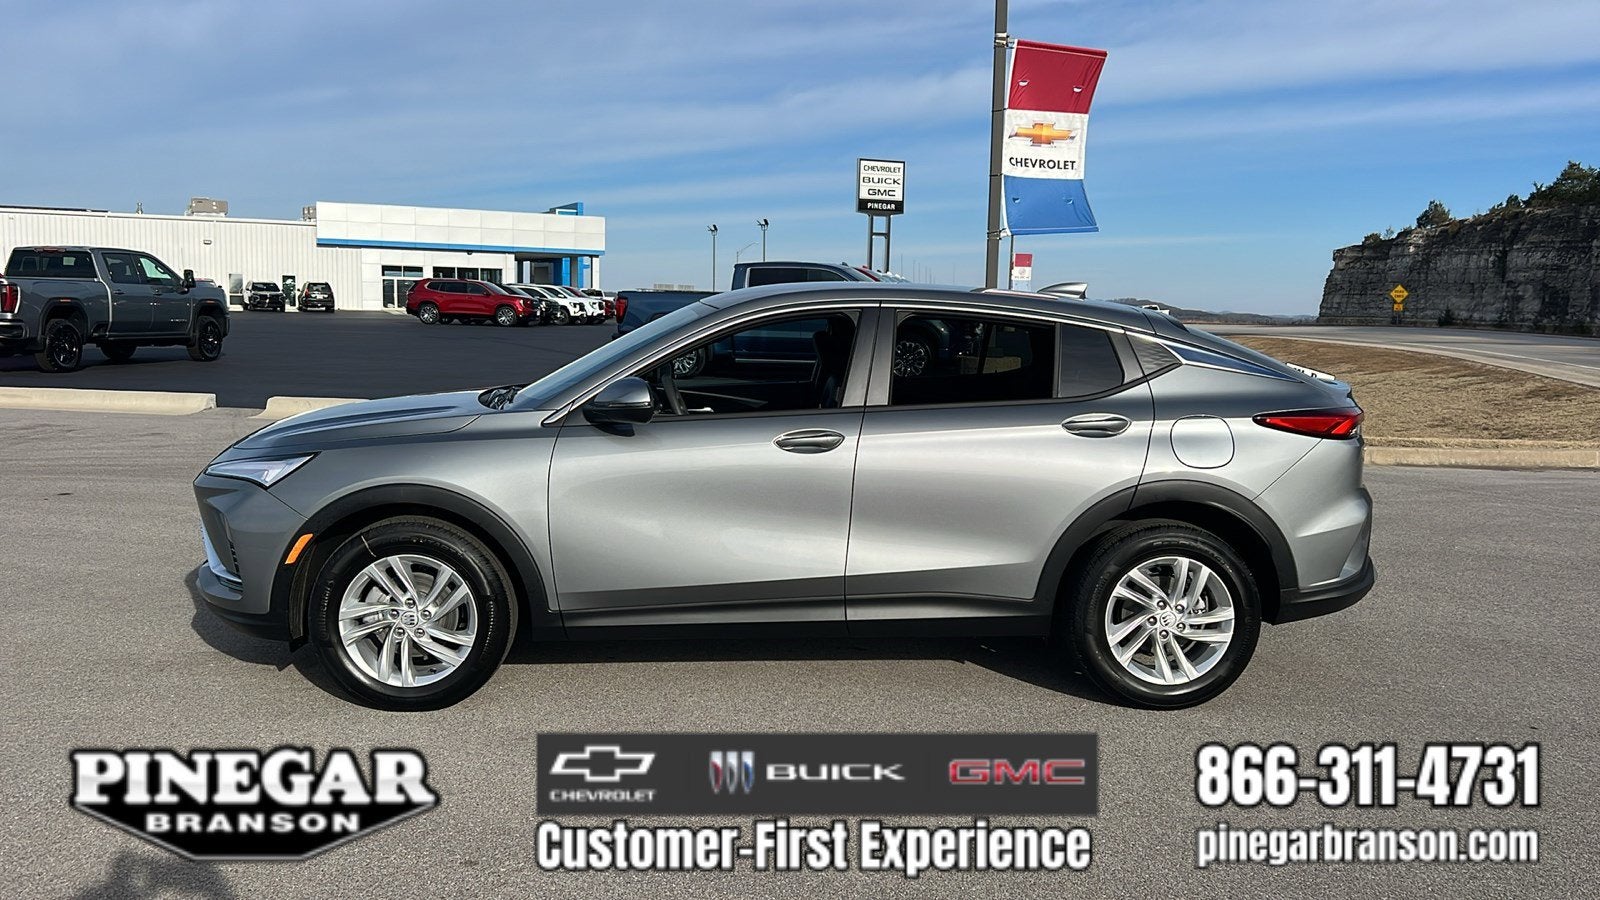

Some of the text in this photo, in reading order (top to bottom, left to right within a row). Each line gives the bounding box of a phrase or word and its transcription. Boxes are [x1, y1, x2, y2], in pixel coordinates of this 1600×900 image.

[1009, 156, 1076, 170] CHEVROLET
[863, 164, 901, 173] CHEVROLET
[862, 176, 901, 185] BUICK
[867, 188, 896, 197] GMC
[867, 202, 896, 210] PINEGAR
